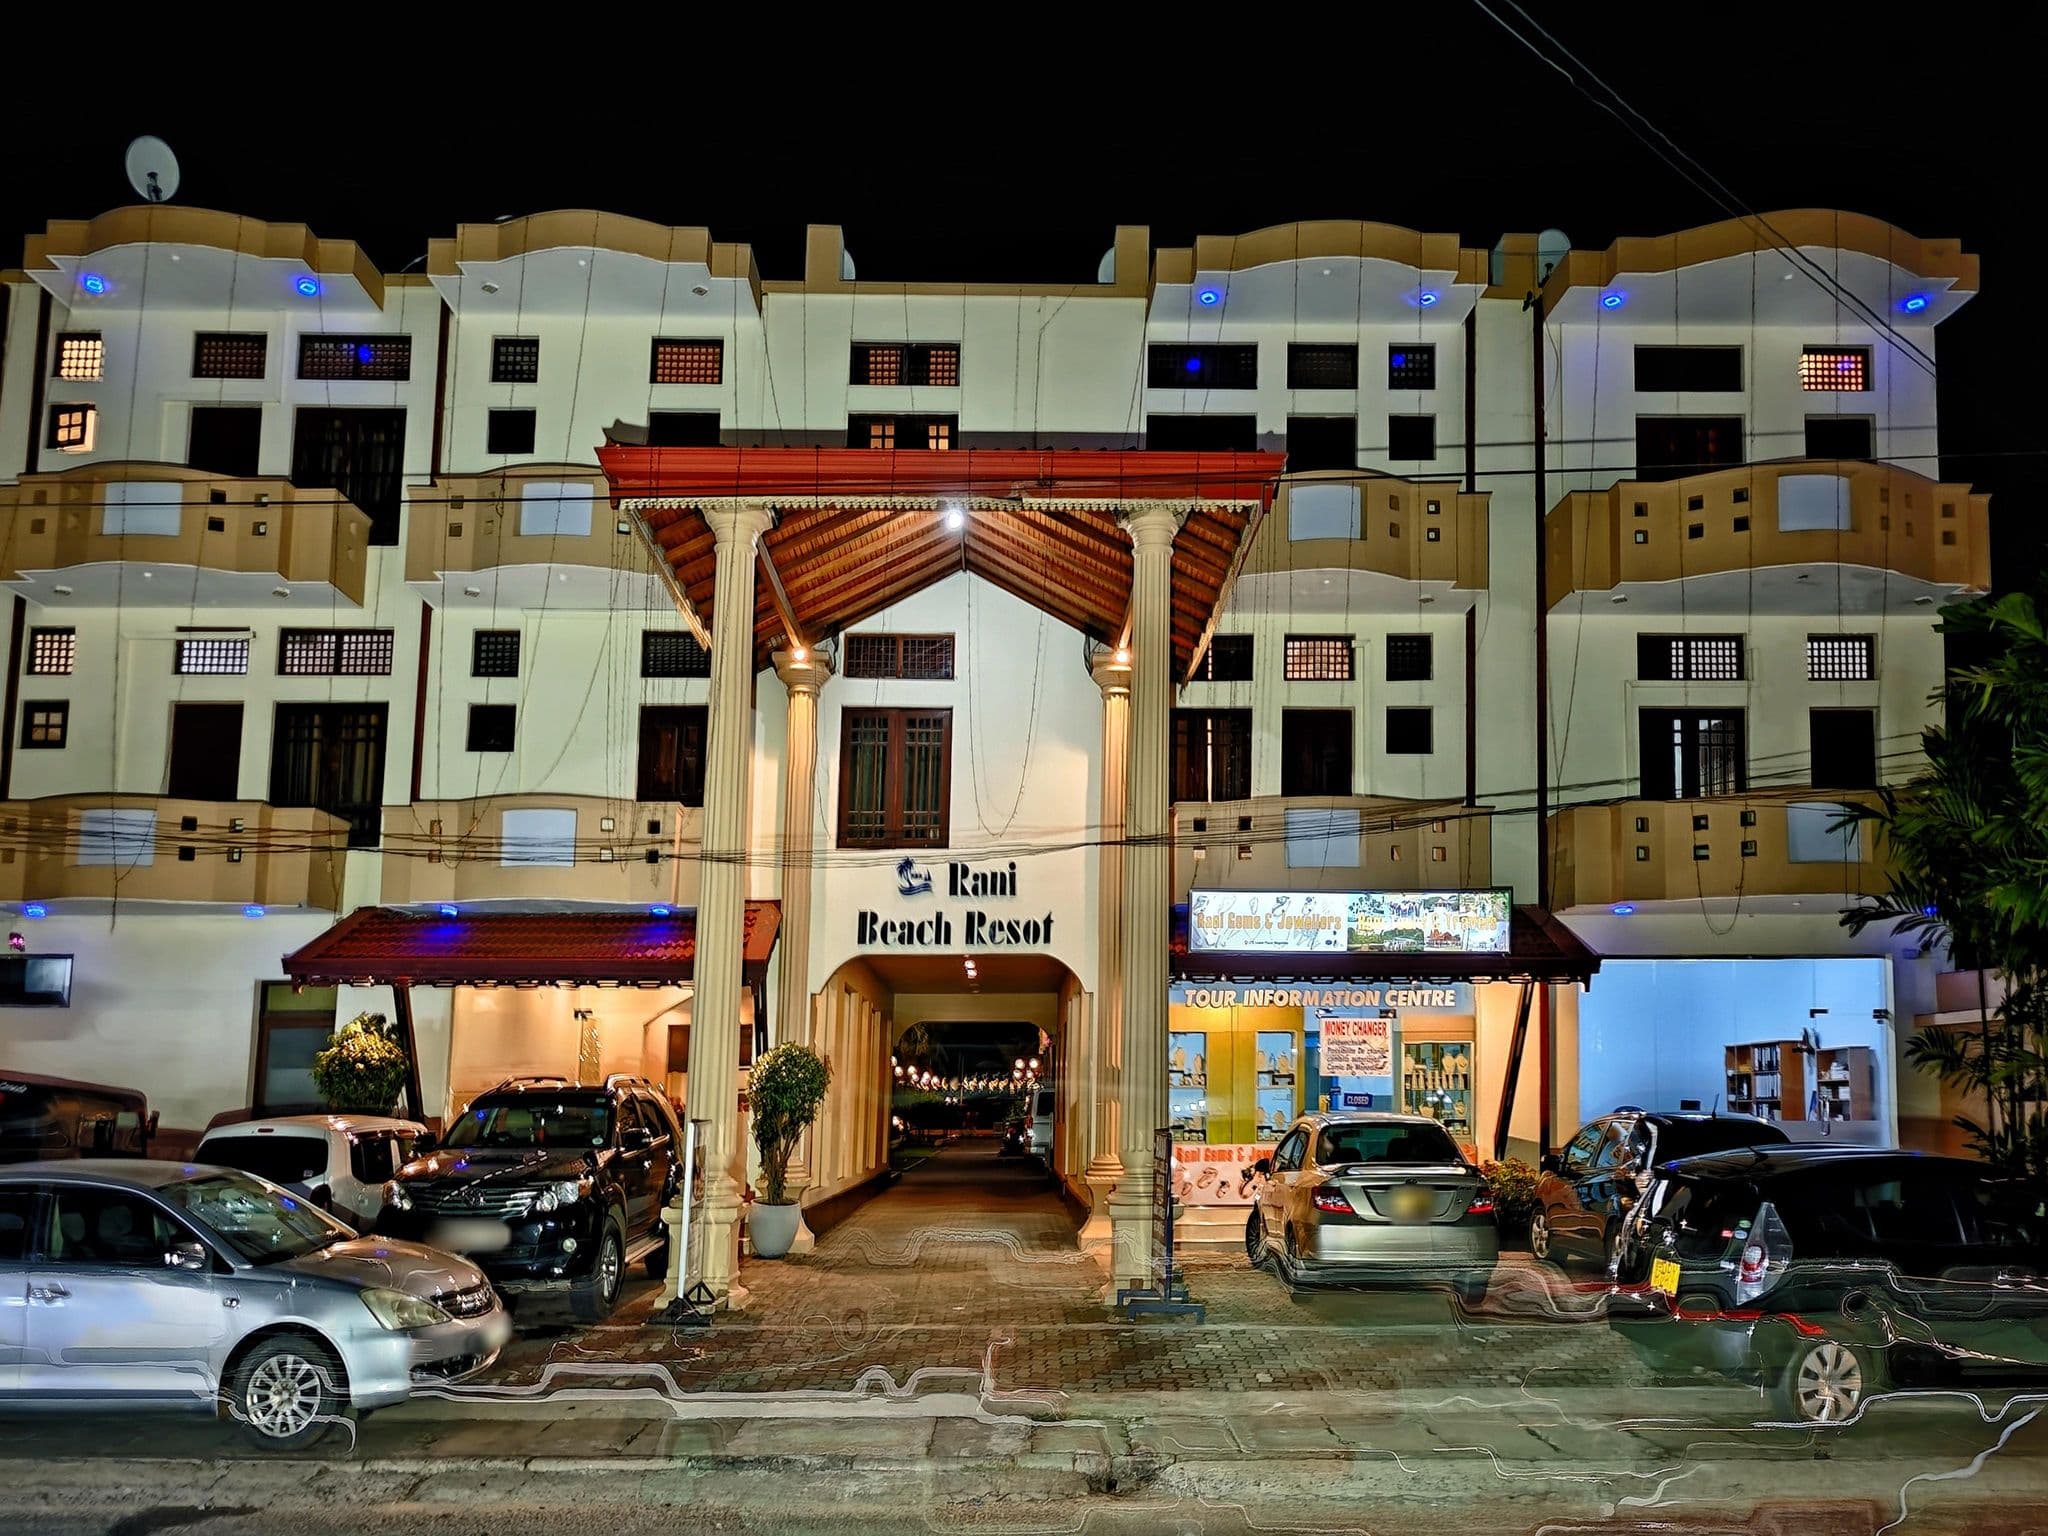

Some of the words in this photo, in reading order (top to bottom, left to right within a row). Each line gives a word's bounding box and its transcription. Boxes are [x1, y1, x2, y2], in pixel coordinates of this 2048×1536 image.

[948, 862, 1017, 897] Rani
[857, 911, 952, 946] Beach
[965, 911, 1054, 946] Resot
[1228, 911, 1261, 930] Gems
[1264, 912, 1273, 930] &
[1277, 911, 1342, 931] Jewellers
[1184, 988, 1237, 1008] TOUR
[1243, 988, 1381, 1008] INFORMATION
[1385, 988, 1456, 1007] CENTRE
[1325, 1020, 1351, 1036] MONEY
[1353, 1020, 1387, 1037] CHANGER
[1346, 1095, 1370, 1105] CLOSED
[1204, 1148, 1234, 1163] Gems
[1236, 1146, 1245, 1162] &
